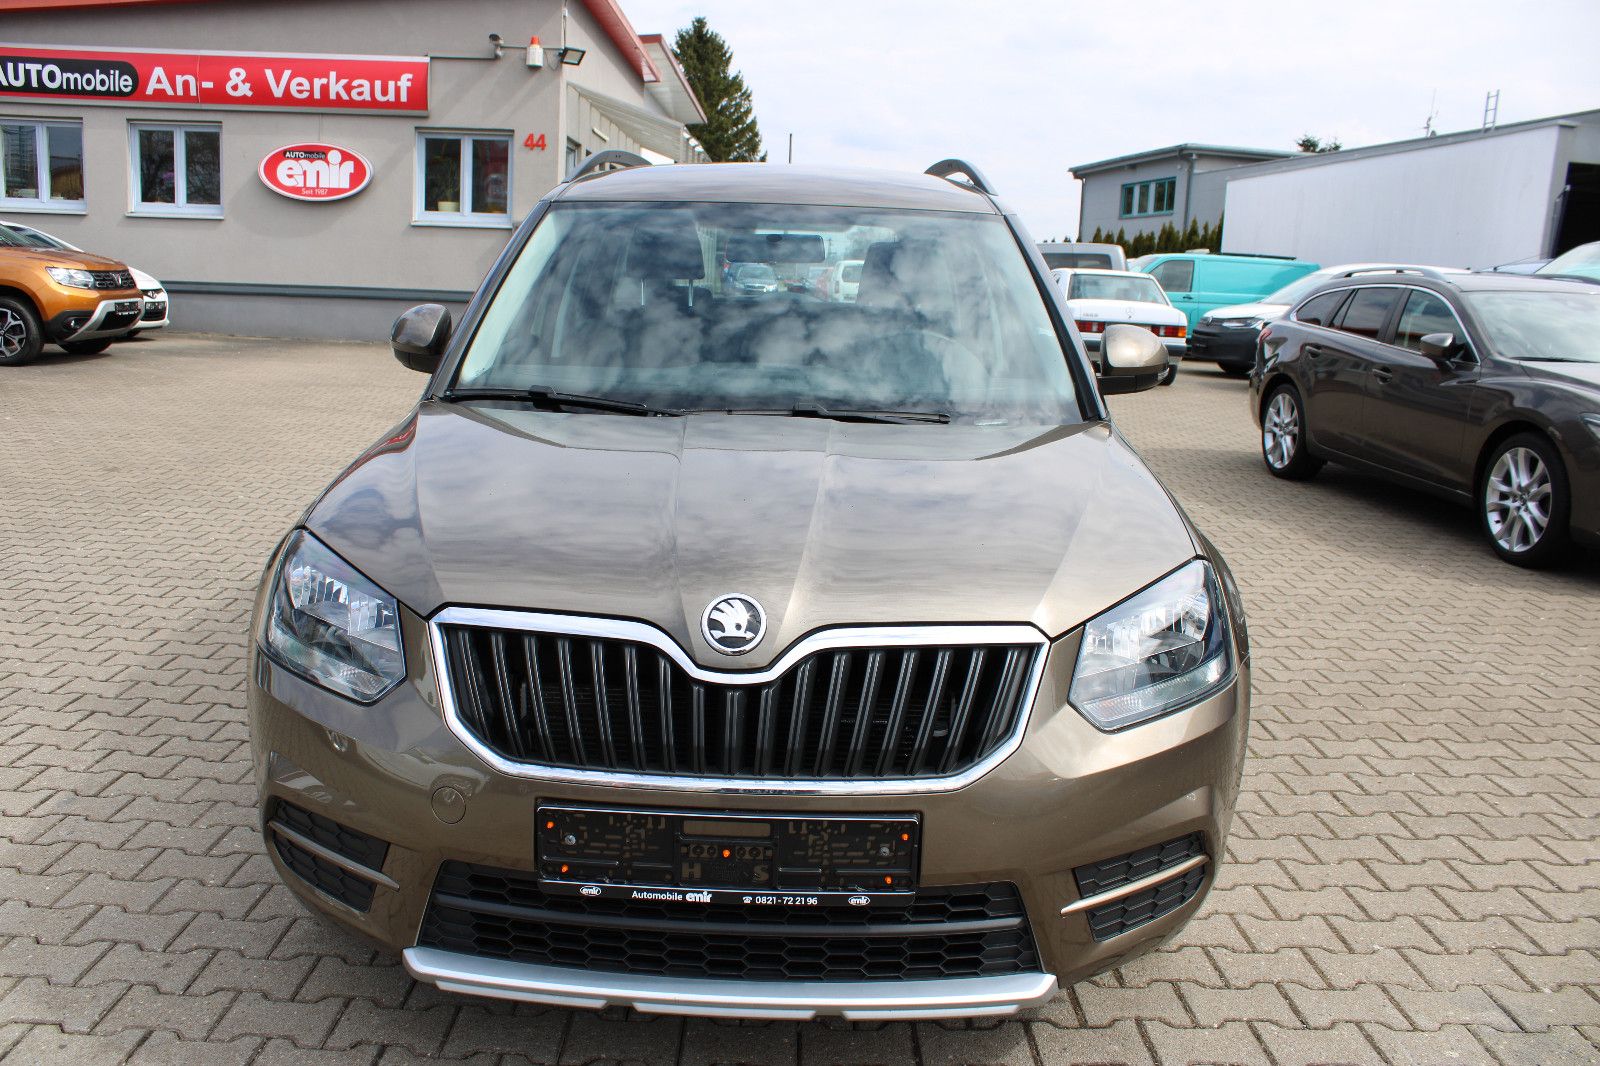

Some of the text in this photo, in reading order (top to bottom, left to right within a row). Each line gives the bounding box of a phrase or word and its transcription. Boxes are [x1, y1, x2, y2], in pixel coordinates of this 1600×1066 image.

[145, 66, 214, 97] An-
[225, 67, 254, 98] &
[264, 68, 414, 103] Verkauf
[523, 132, 547, 151] 44
[276, 149, 355, 189] emir
[581, 887, 599, 896] emir
[631, 890, 713, 904] Automobile emir
[850, 896, 868, 905] emir
